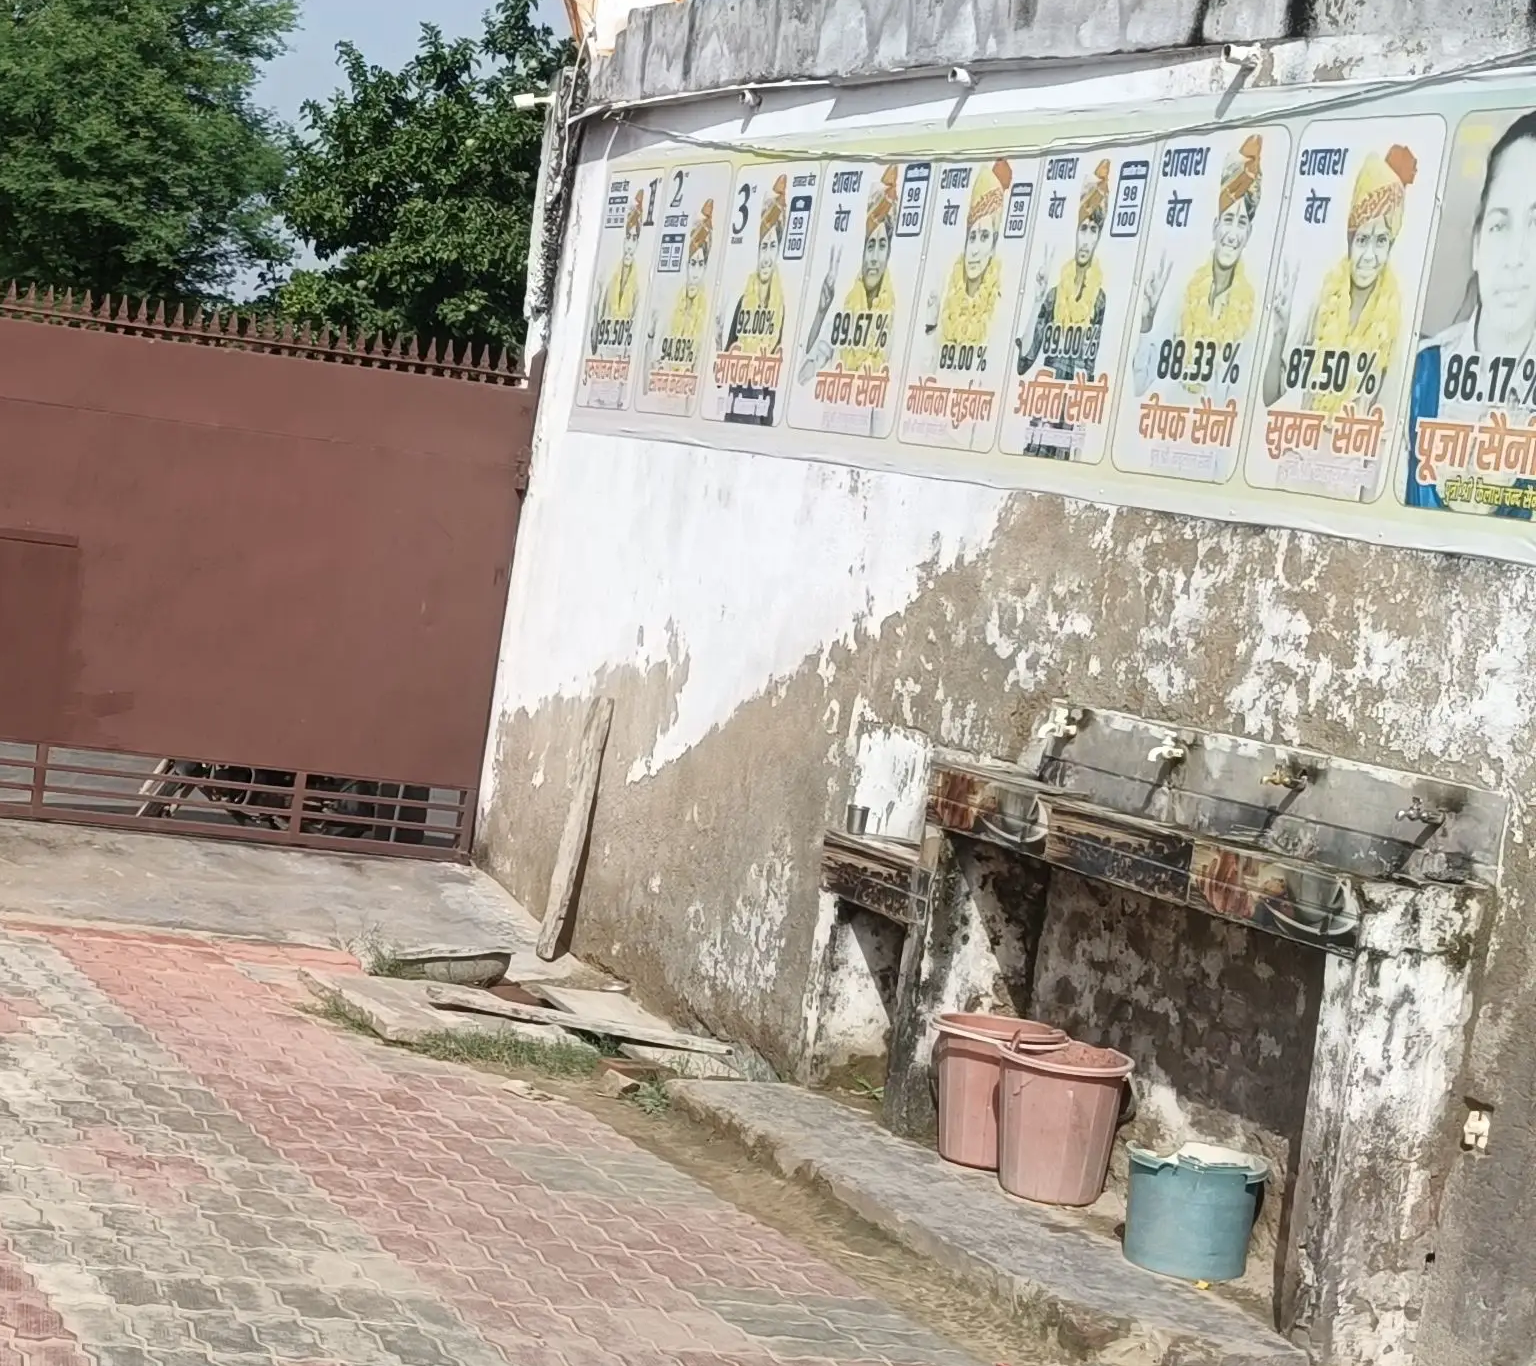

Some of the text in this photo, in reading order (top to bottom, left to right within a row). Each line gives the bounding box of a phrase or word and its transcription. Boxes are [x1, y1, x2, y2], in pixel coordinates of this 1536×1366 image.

[1046, 158, 1079, 181] शाबाश
[1162, 147, 1211, 178] शाबाश
[1300, 148, 1349, 177] शाबाश
[832, 171, 863, 193] शाबाश
[940, 167, 972, 190] शाबाश
[906, 187, 921, 202] 98
[1012, 200, 1024, 212] 98
[1048, 191, 1066, 219] बेटा
[1123, 186, 1137, 202] 98
[1304, 188, 1331, 225] बेटा
[792, 217, 804, 229] 99
[834, 204, 851, 232] बेटा
[901, 211, 919, 227] 100
[942, 198, 960, 226] बेटा
[1117, 211, 1135, 227] 100
[1166, 190, 1193, 228] बेटा
[1008, 219, 1023, 232] 100
[788, 238, 802, 251] 100
[598, 319, 633, 347] 95.50%
[737, 310, 774, 335] 92.00%
[831, 311, 888, 347] 89.67 %
[662, 338, 694, 362] 94.83%
[1042, 325, 1099, 359] 89.00 %
[752, 346, 783, 388] सैनी
[939, 344, 987, 372] 89.00 %
[1157, 339, 1240, 385] 88.33 %
[1286, 347, 1377, 395] 87.50 %
[814, 362, 890, 408] नवीन सैनी
[1444, 354, 1516, 403] 86.17
[905, 375, 951, 417] मोनिका
[1013, 370, 1108, 424] अमित सैनी
[1138, 392, 1190, 442] दीपक
[1191, 397, 1238, 447] सैनी
[1265, 405, 1384, 460] सुमन सैनी
[1417, 419, 1475, 481] पूजा
